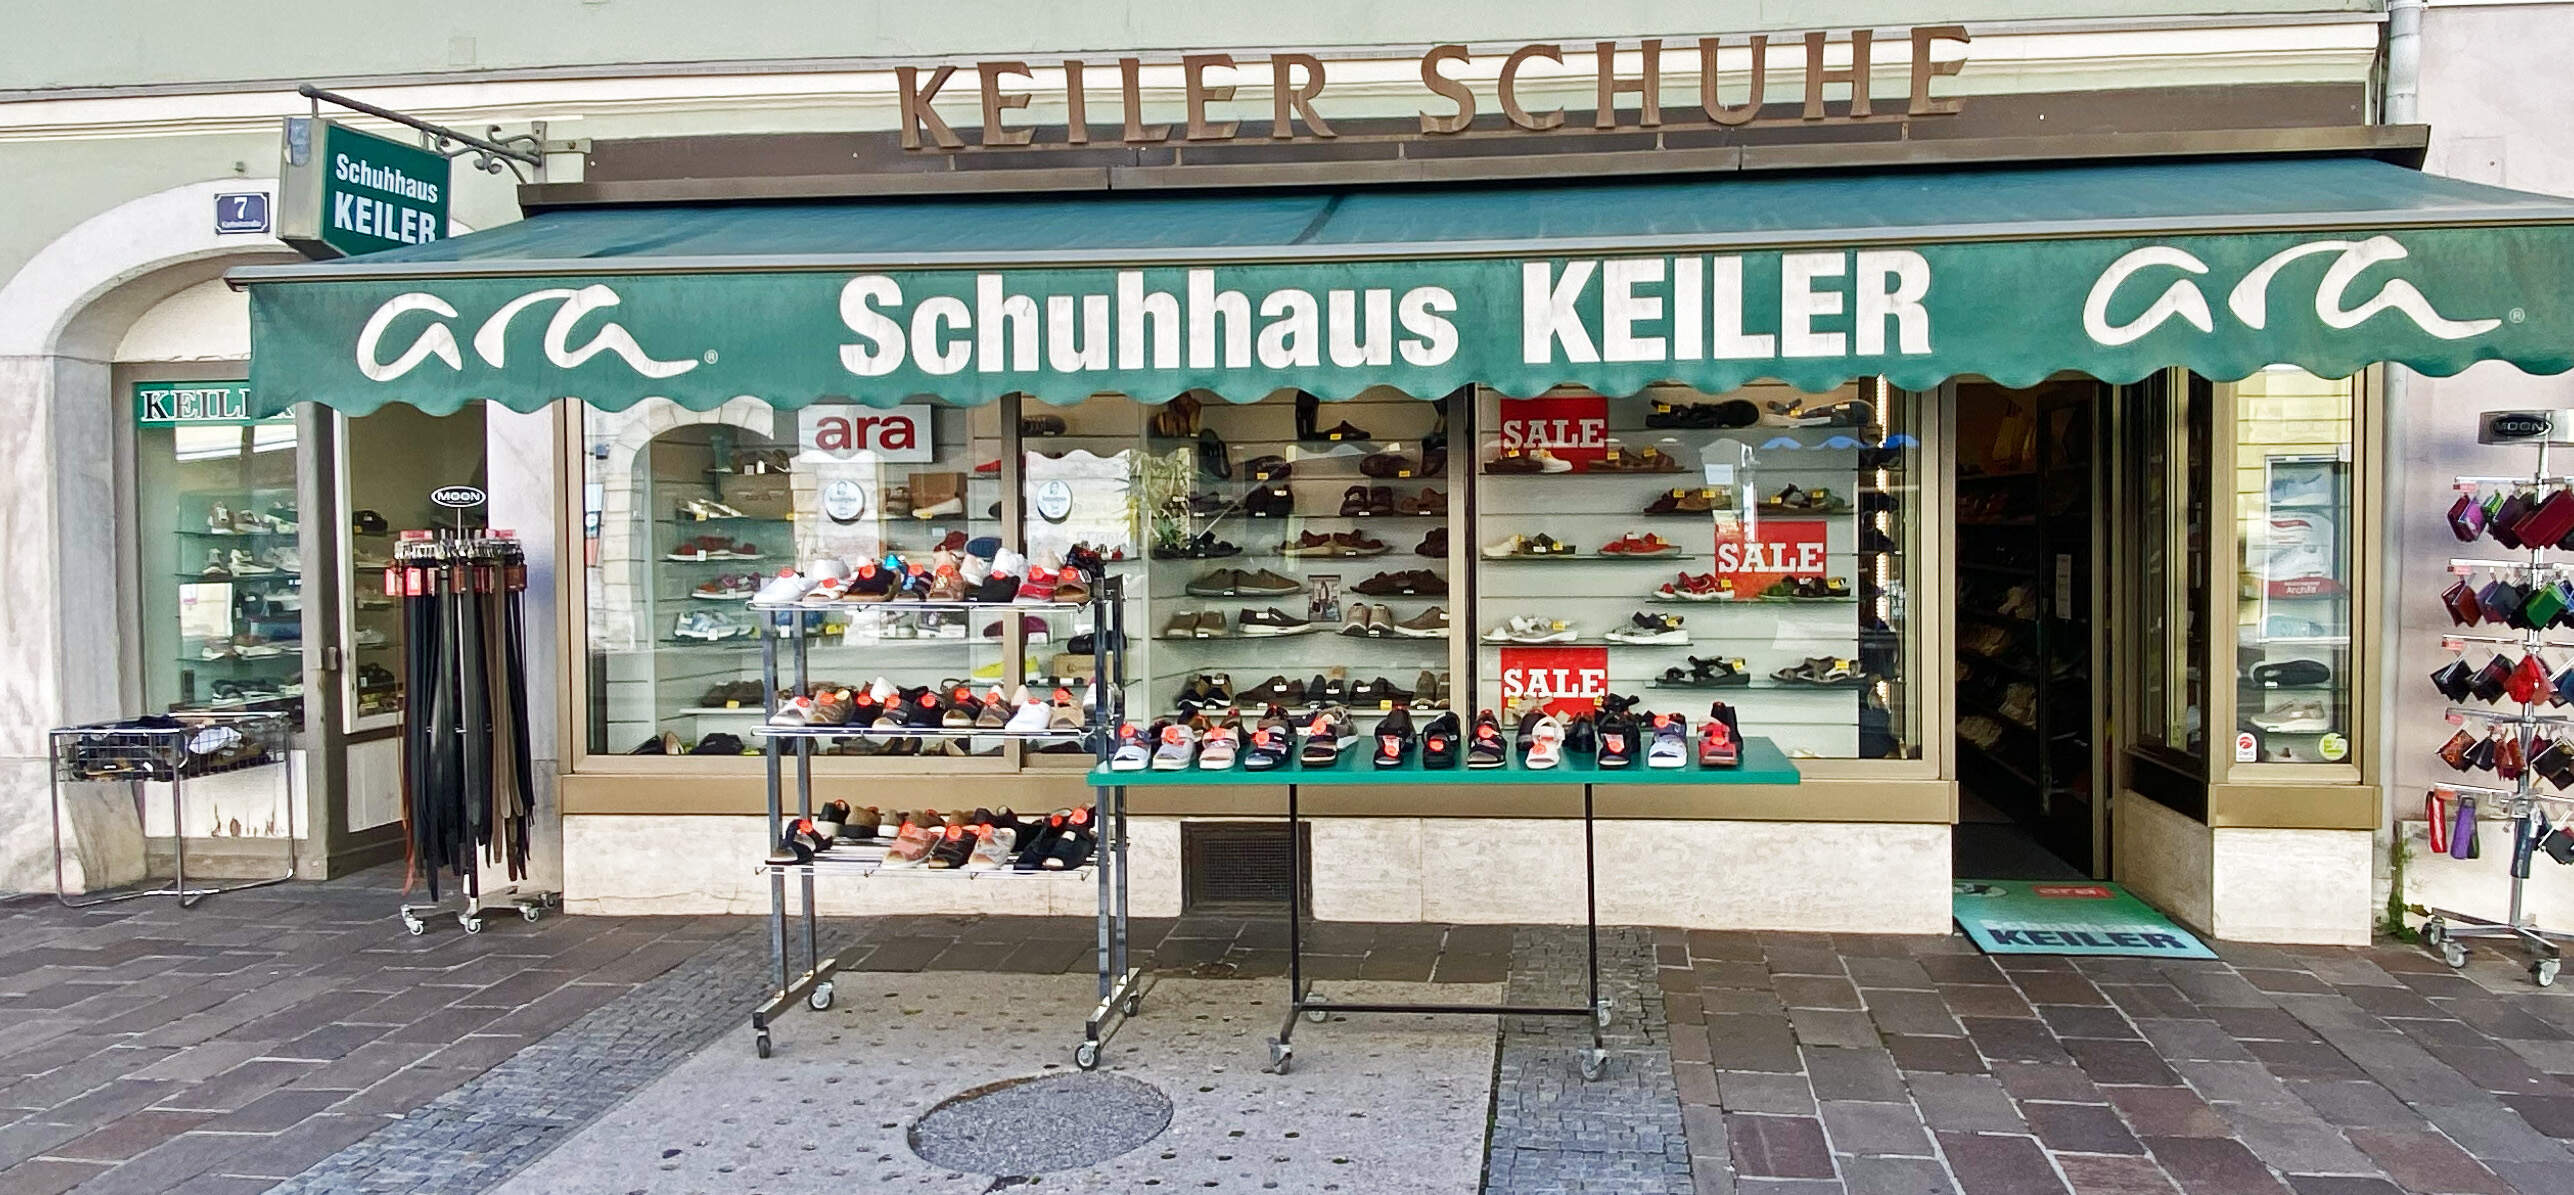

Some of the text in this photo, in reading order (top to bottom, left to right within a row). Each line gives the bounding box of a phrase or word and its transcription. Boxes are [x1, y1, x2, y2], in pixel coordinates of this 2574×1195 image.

[895, 24, 1972, 149] KEILER SCHUHE
[335, 152, 438, 204] Schuhhaus
[233, 196, 248, 220] 7
[334, 190, 437, 244] KEILER
[2082, 235, 2502, 347] ara
[839, 250, 1932, 376] Schuhhaus KEILER
[356, 283, 699, 382] ara
[140, 389, 296, 422] KEIL
[815, 415, 916, 451] ara
[1503, 418, 1606, 449] SALE
[437, 491, 481, 501] MOON
[1718, 542, 1825, 573] SALE
[1503, 668, 1606, 698] SALE
[1986, 929, 2189, 949] KEILER
